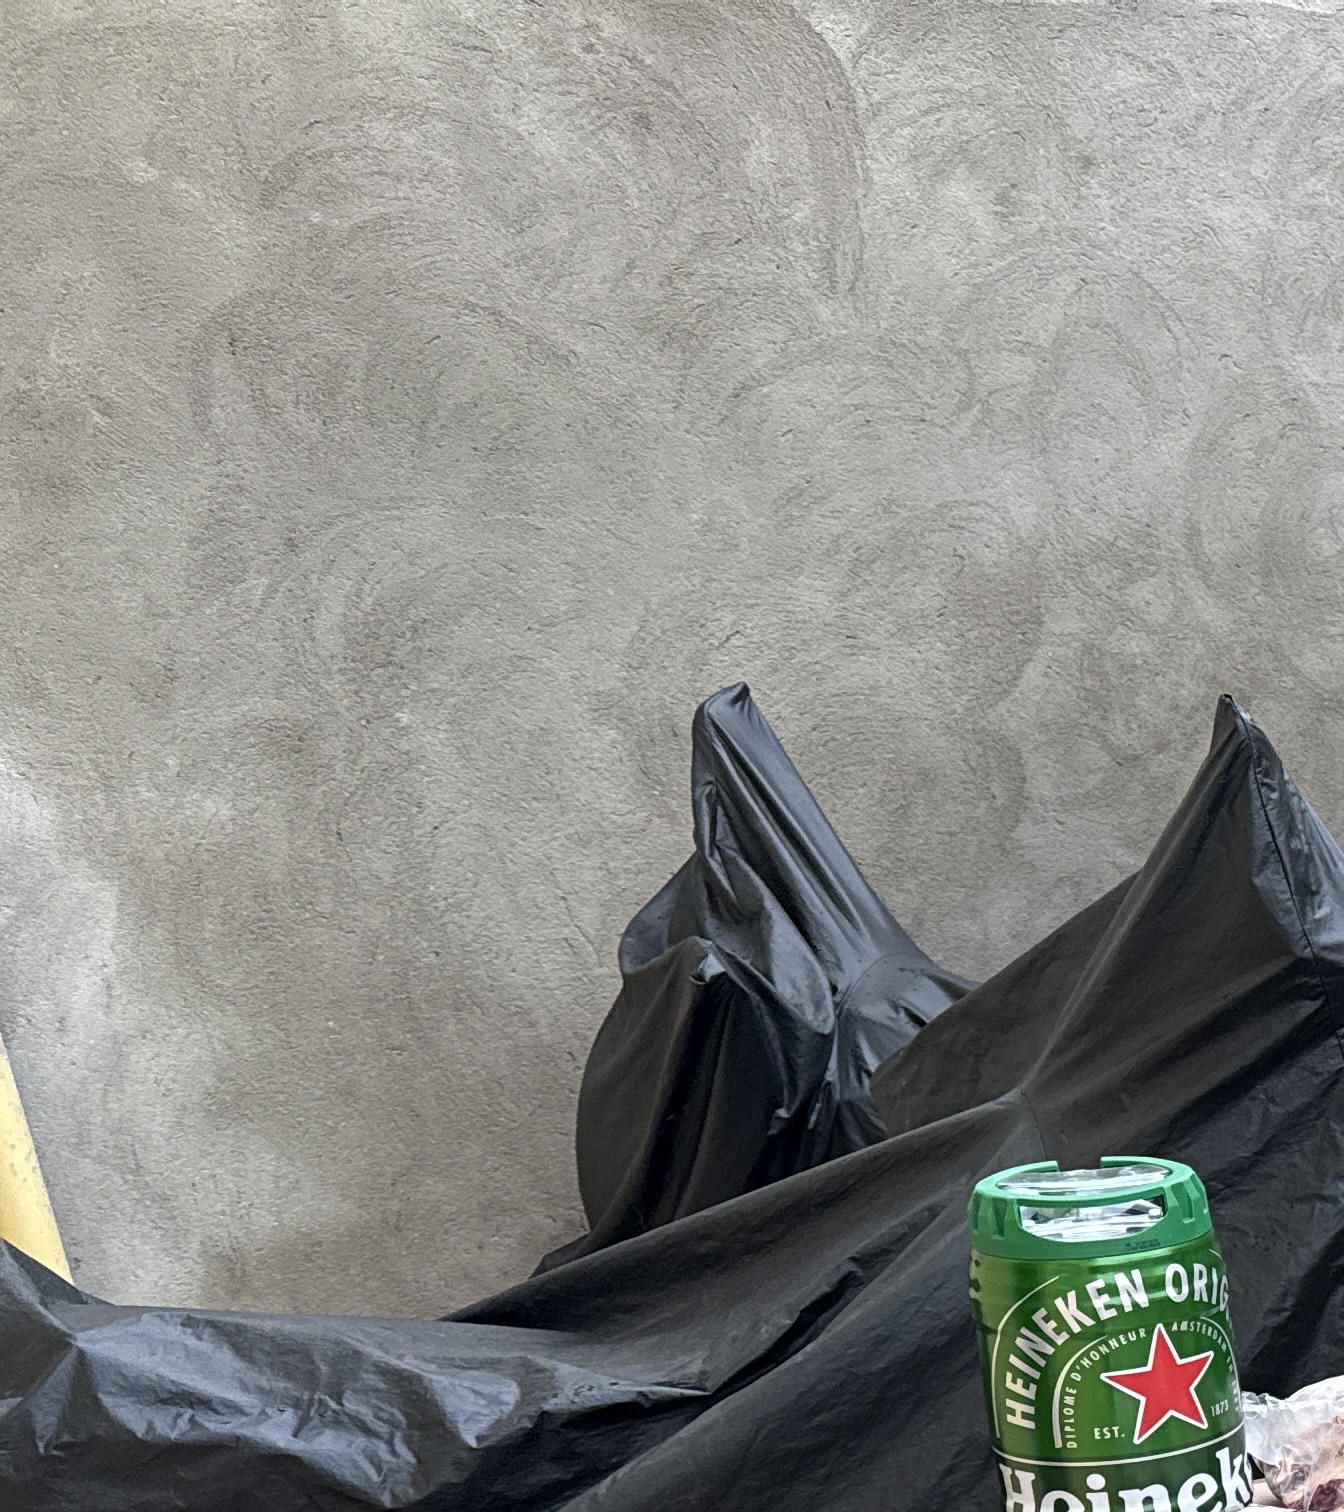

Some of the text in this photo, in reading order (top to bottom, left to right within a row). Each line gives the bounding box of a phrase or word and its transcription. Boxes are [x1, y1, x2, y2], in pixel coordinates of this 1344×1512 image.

[1004, 1262, 1231, 1430] HEINEKEN ORIG
[1069, 1327, 1147, 1382] D'HONNEUR
[1062, 1386, 1078, 1449] DIPLOME
[1093, 1426, 1126, 1440] EST.
[1210, 1399, 1230, 1418] 1873
